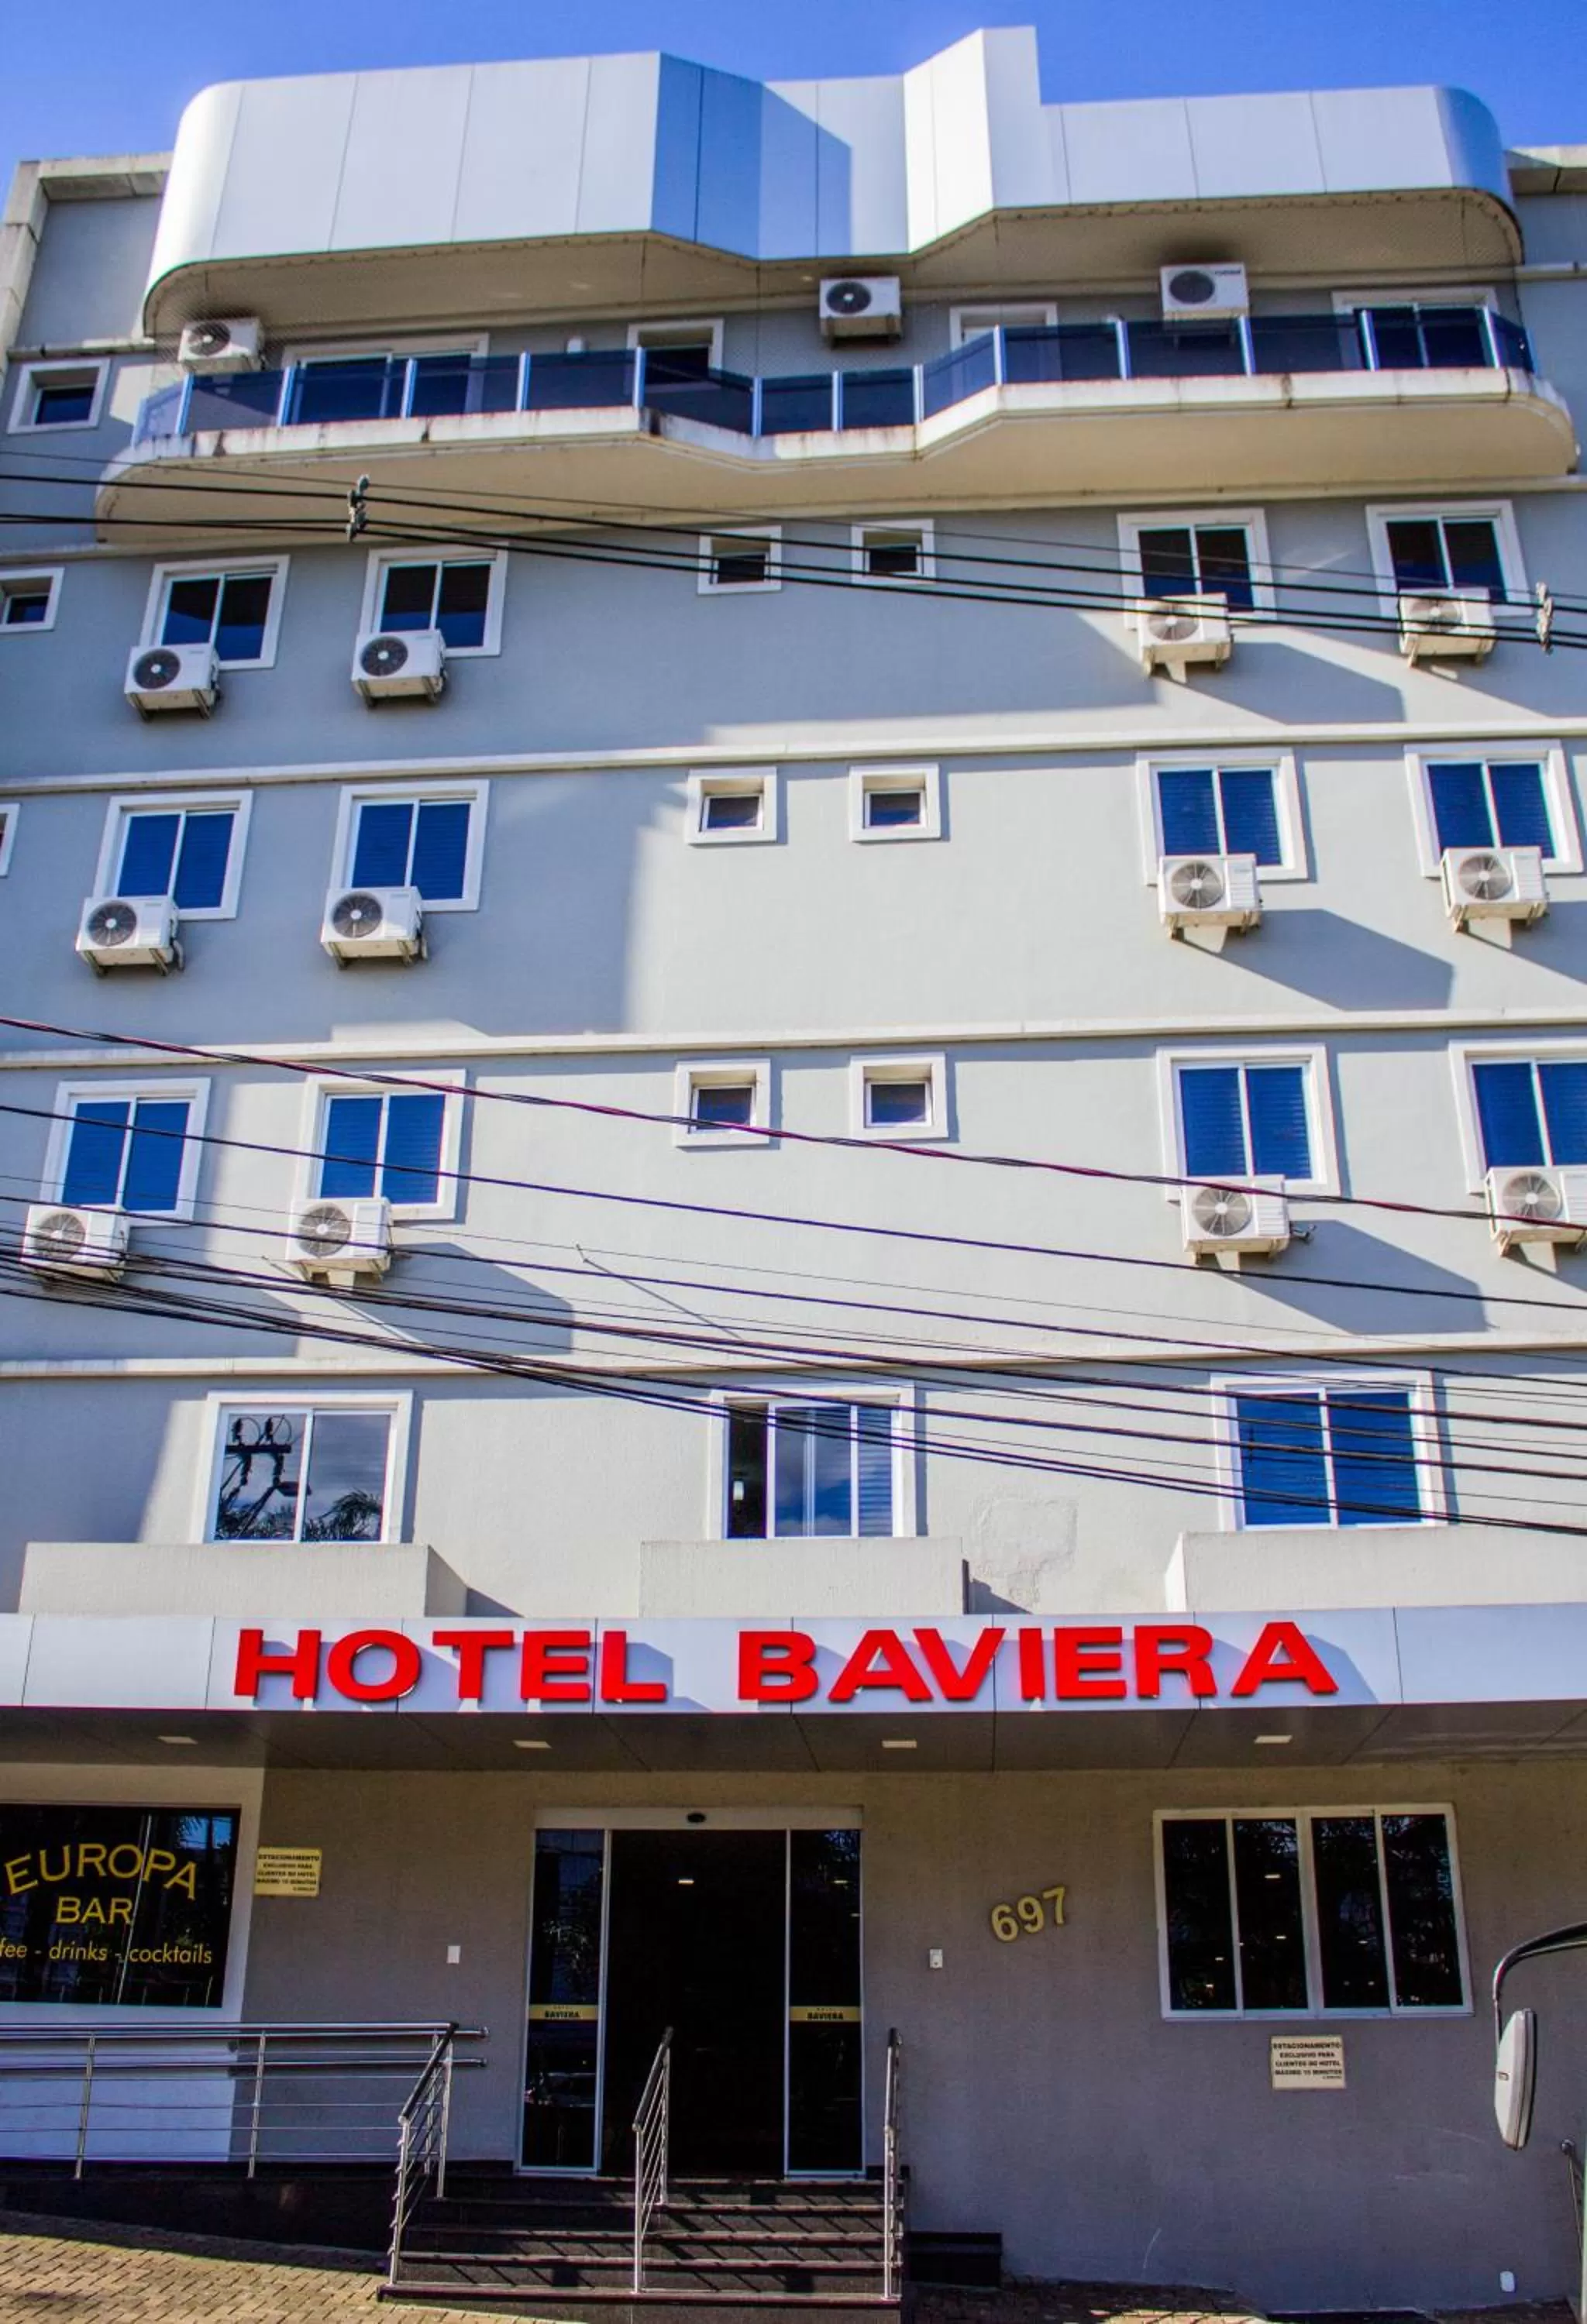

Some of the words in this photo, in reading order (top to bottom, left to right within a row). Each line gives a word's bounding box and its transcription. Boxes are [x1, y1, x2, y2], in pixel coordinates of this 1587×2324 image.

[234, 1629, 666, 1702] HOTEL
[738, 1621, 1338, 1702] BAVIERA
[4, 1843, 198, 1900] EUROPA
[55, 1896, 134, 1925] BAR
[991, 1886, 1066, 1943] 697
[49, 1938, 108, 1961] drinks
[129, 1941, 212, 1965] cocktails
